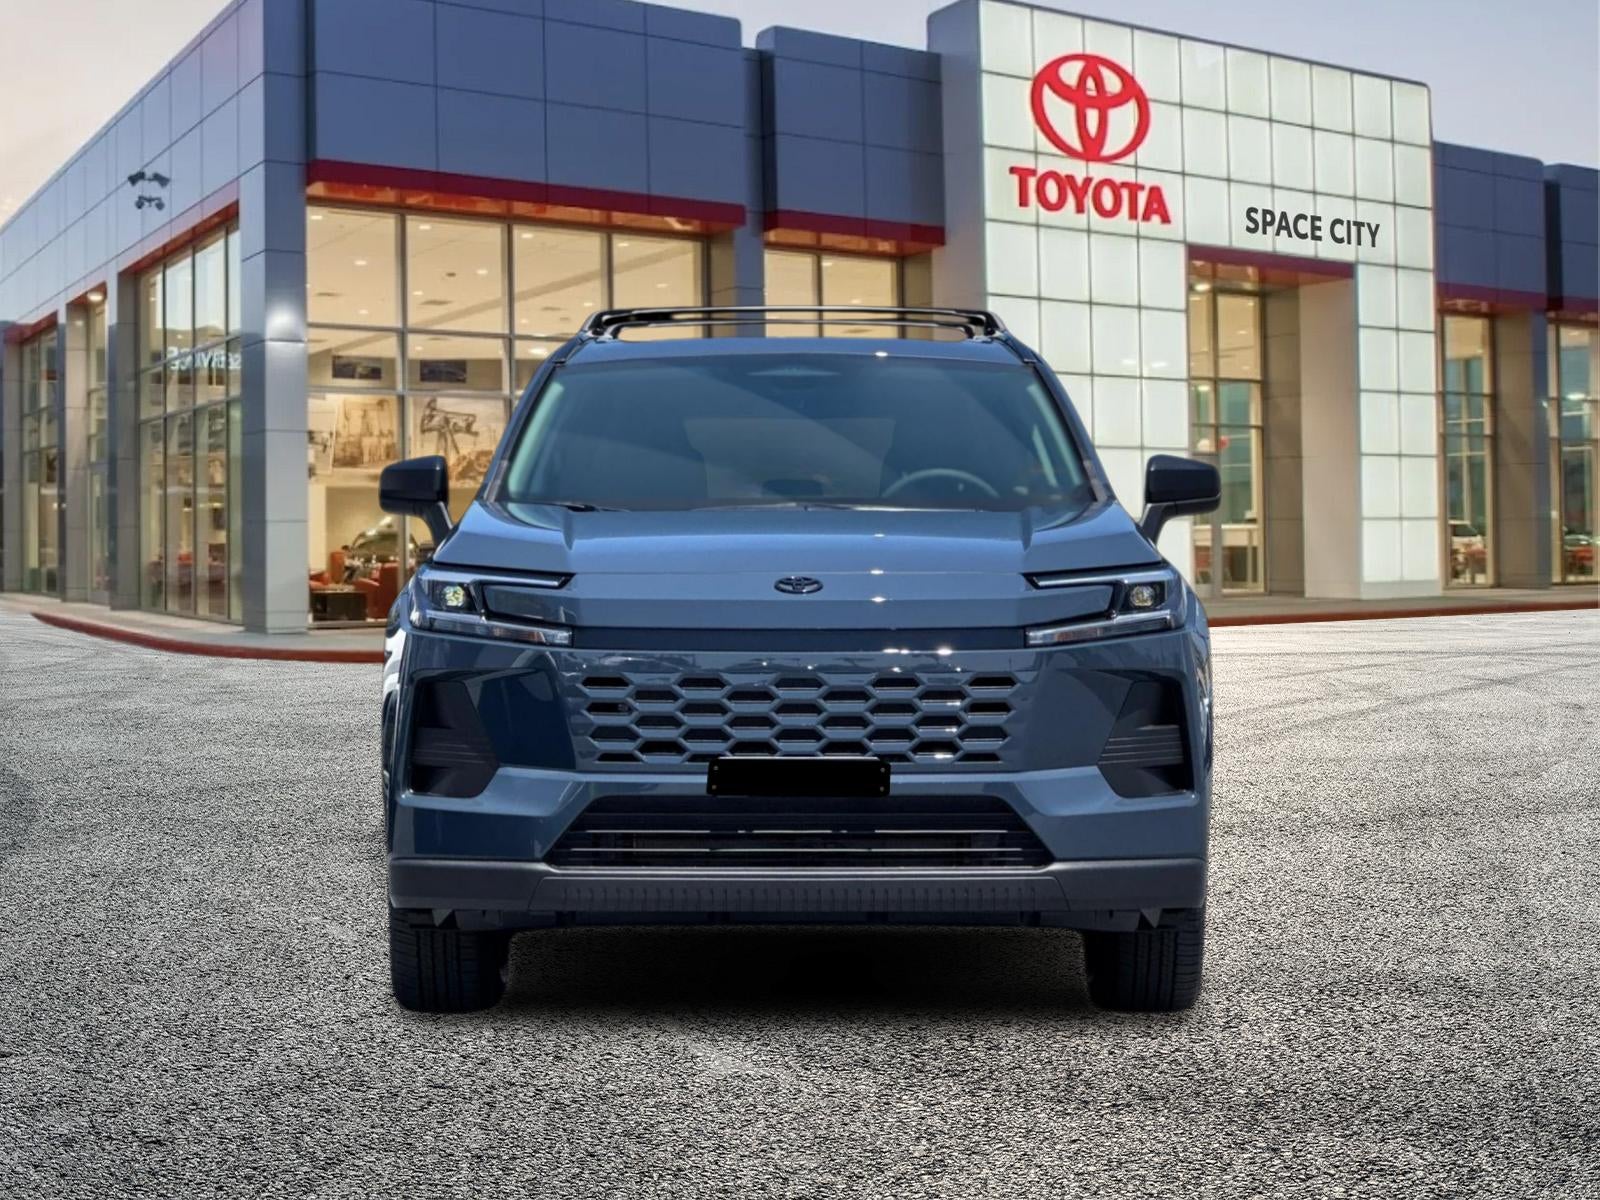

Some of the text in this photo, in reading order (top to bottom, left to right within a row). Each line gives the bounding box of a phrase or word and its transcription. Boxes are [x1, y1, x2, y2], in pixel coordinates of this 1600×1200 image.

[1009, 166, 1171, 225] TOYOTA
[1245, 206, 1381, 248] SPACE CITY
